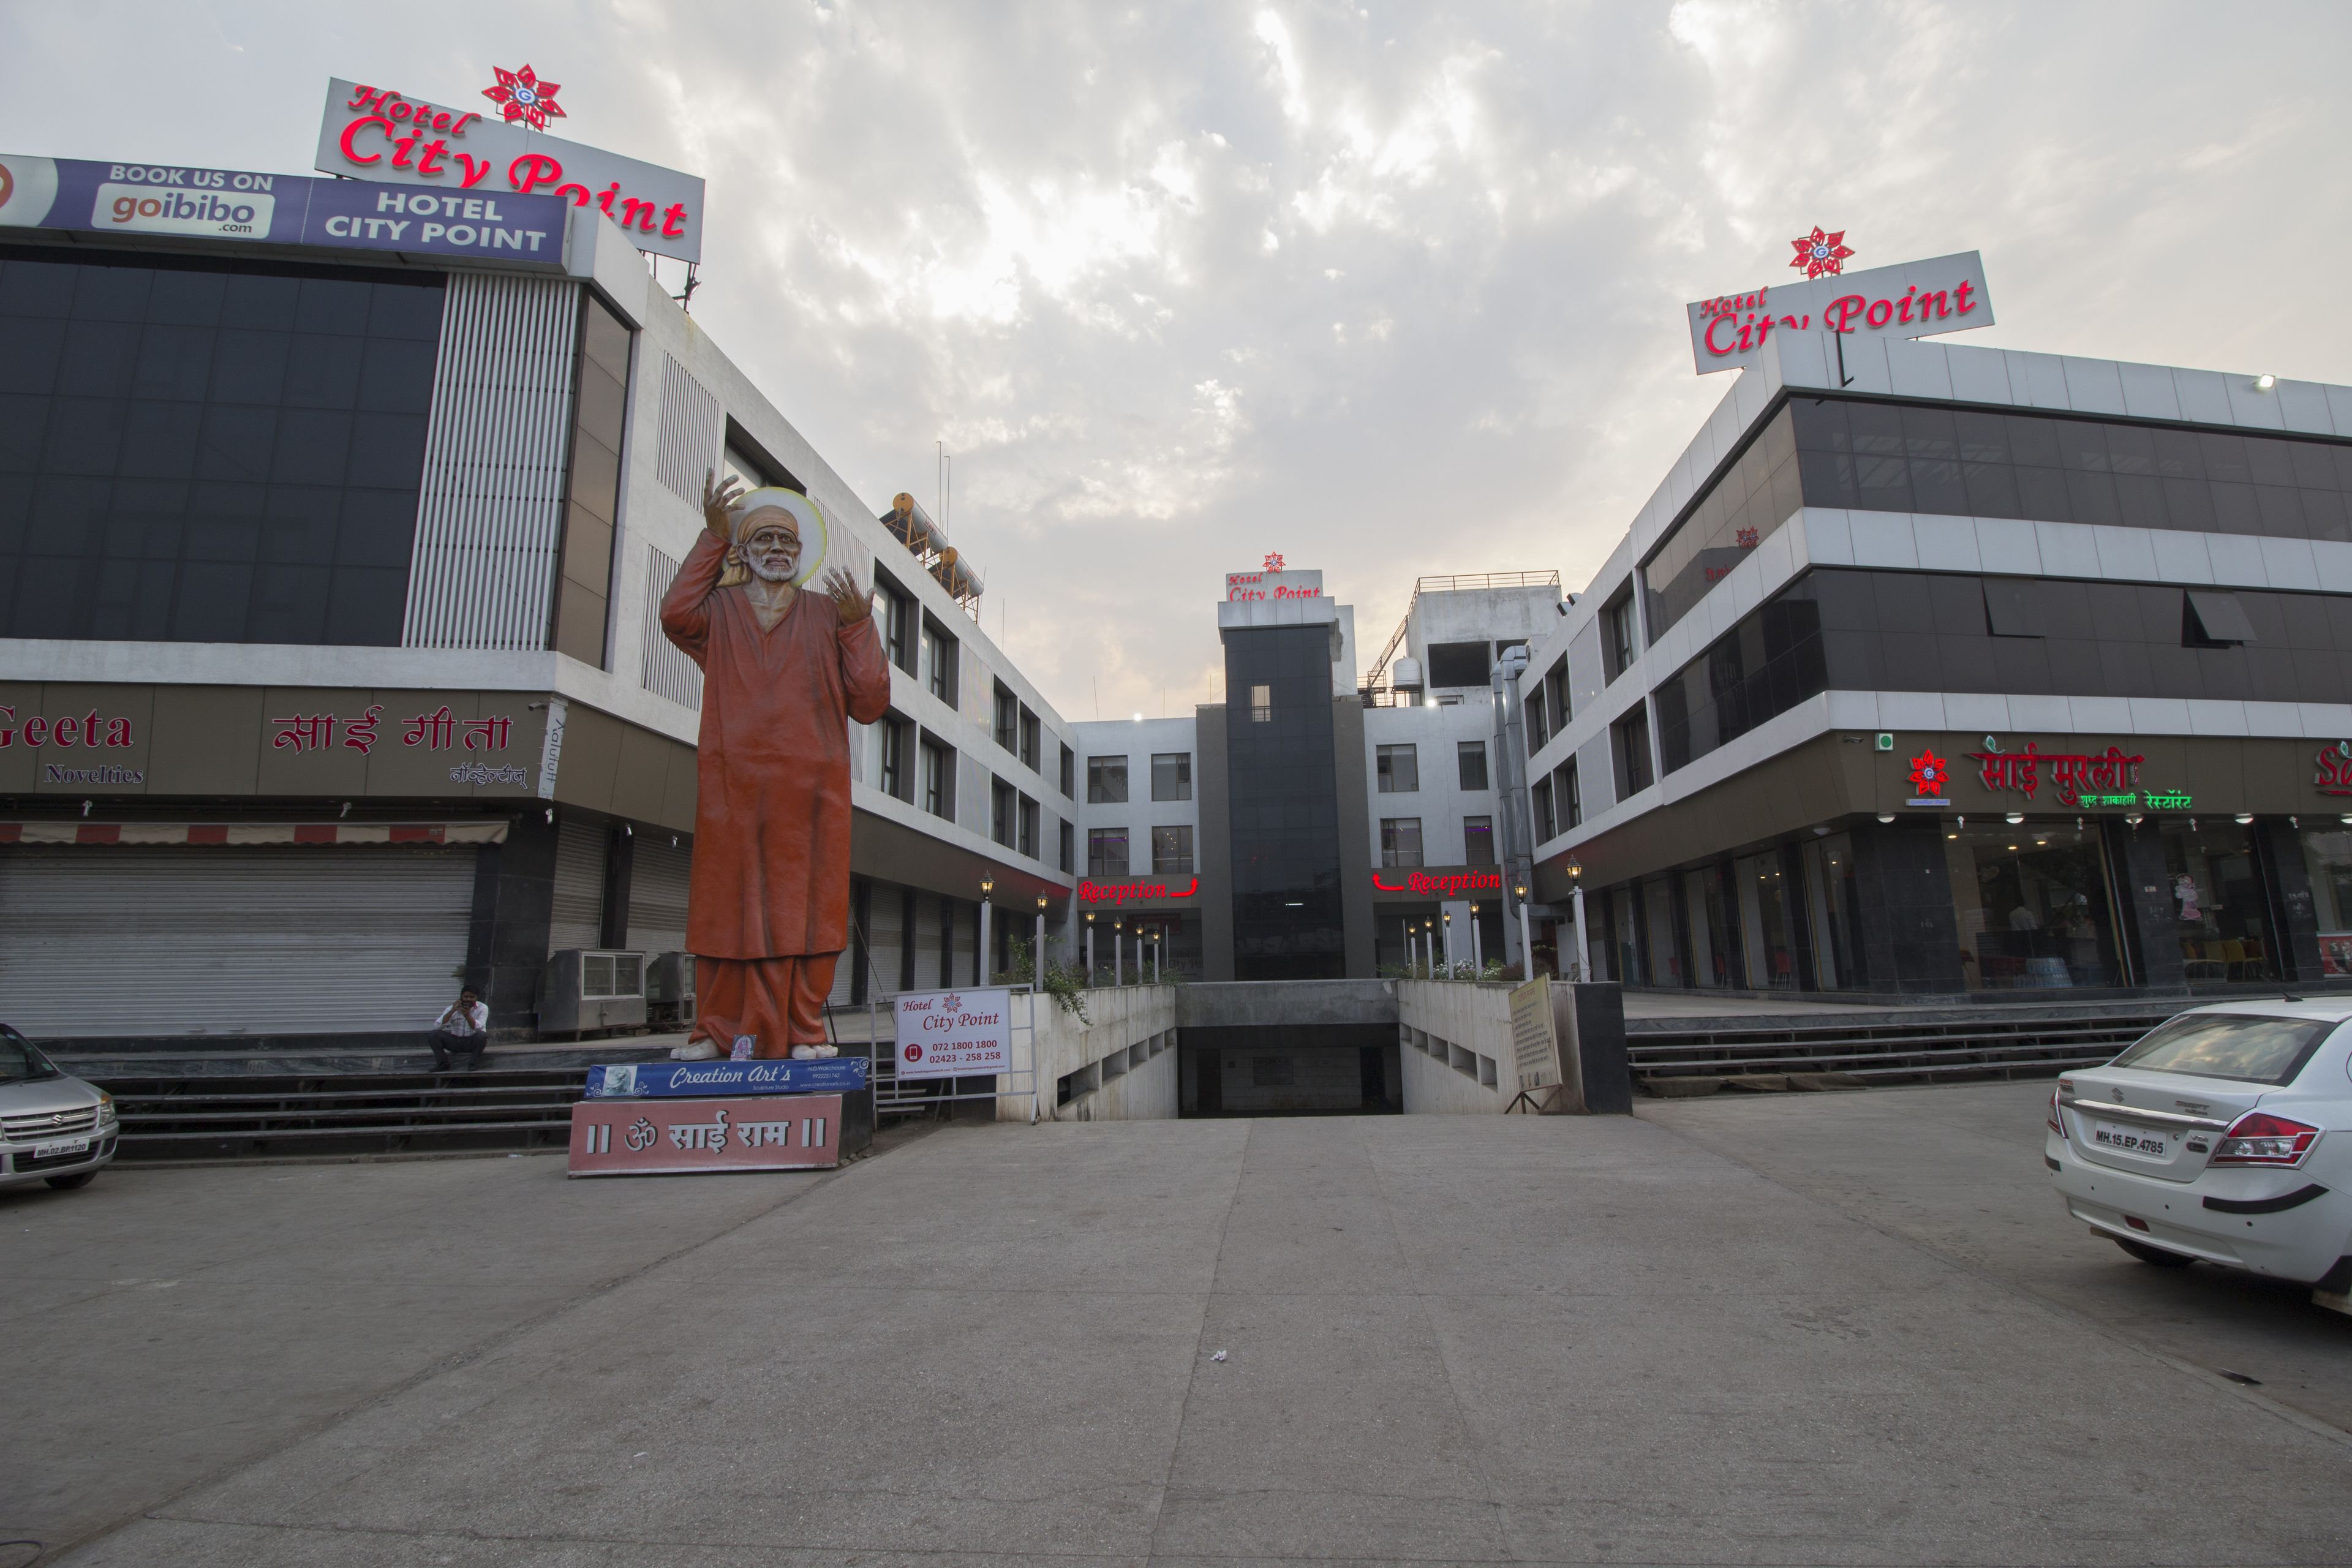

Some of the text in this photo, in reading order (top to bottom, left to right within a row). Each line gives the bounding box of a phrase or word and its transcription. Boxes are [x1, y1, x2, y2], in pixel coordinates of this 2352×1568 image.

[347, 85, 483, 137] Hotel
[339, 115, 491, 189] City
[110, 165, 273, 191] BOOK US ON
[112, 192, 255, 224] goibibo
[377, 192, 503, 221] HOTEL
[219, 224, 252, 233] .com
[325, 216, 546, 251] CITY POINT
[1700, 286, 1768, 318] Hotel
[1823, 279, 1977, 333] Point
[1229, 572, 1264, 586] Hotel
[1273, 585, 1321, 600] Point
[0, 706, 134, 748] Geeta
[272, 705, 514, 756] साई गीता
[44, 764, 144, 784] Novelties
[1978, 741, 2132, 807] साई मुरली
[2101, 793, 2137, 805] शाकाहारी
[1079, 880, 1167, 905] Reception
[1409, 870, 1501, 895] Reception
[902, 998, 934, 1012] Hotel
[923, 1011, 1000, 1033] City Point
[951, 1041, 973, 1050] 1800
[976, 1039, 997, 1048] 1800
[929, 1055, 957, 1063] 02423
[965, 1053, 982, 1061] 258
[669, 1065, 791, 1088] Creation Art's
[668, 1110, 729, 1155] साई
[737, 1121, 791, 1147] राम
[2095, 1130, 2164, 1154] MH.15.EP.4785
